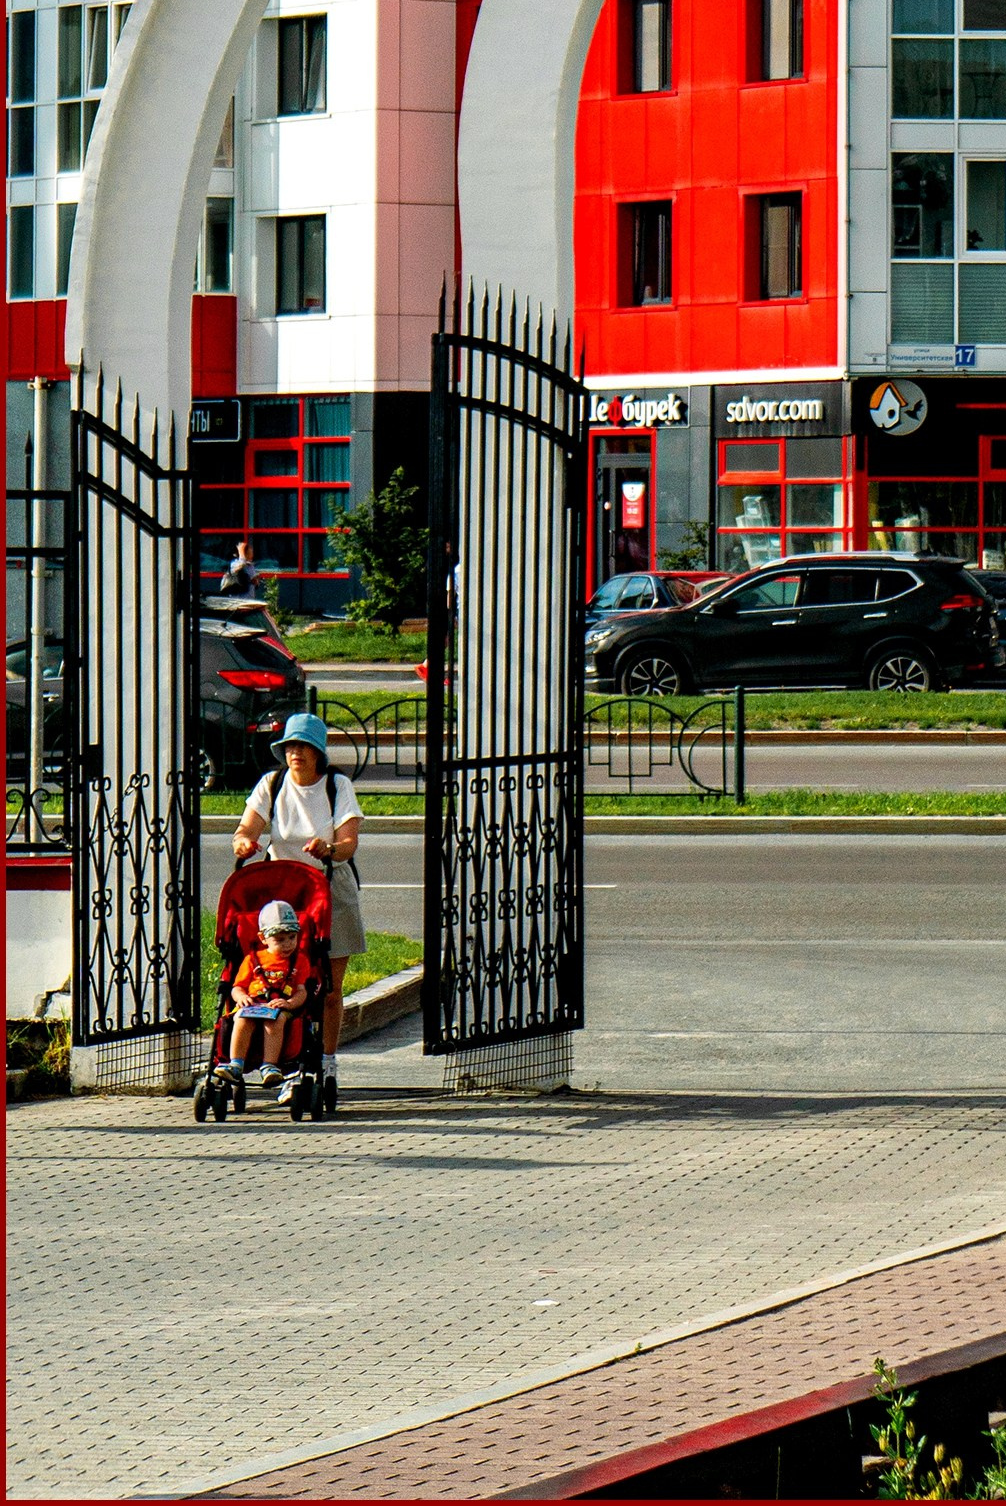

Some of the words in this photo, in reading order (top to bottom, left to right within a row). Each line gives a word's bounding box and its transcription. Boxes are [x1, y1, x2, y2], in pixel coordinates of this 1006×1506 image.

[890, 354, 953, 362] Университетская
[956, 349, 975, 363] 17
[726, 395, 823, 423] sdvor.com
